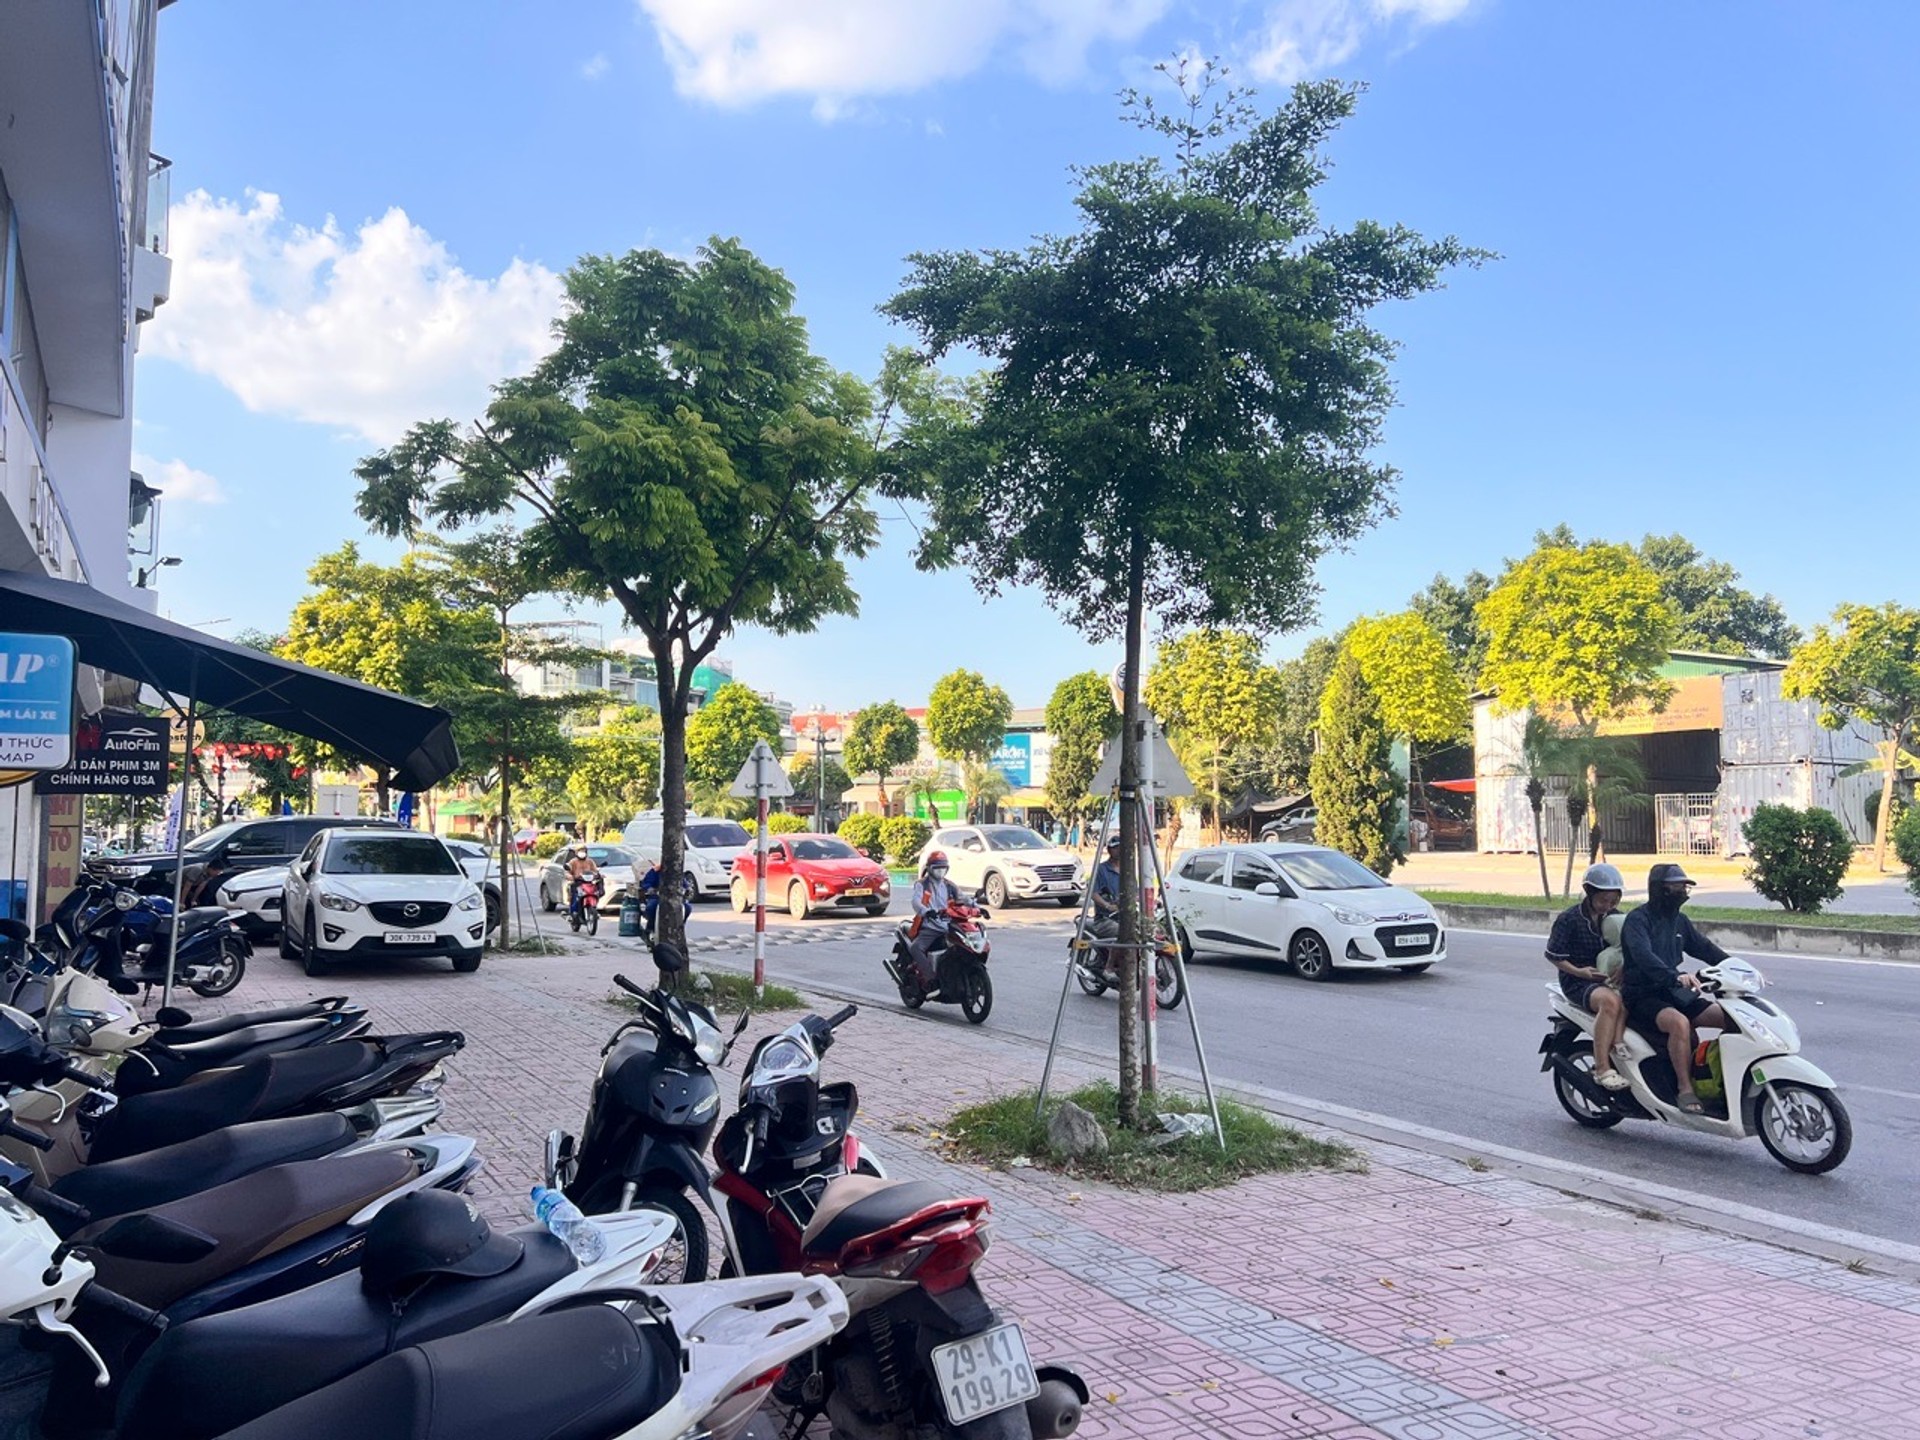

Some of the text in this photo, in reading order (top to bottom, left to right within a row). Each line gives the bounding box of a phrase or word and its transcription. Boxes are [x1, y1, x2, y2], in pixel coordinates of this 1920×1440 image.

[15, 708, 36, 719] LÁI
[40, 711, 57, 720] XE
[8, 736, 54, 749] THỨC
[104, 738, 160, 752] AutoFilm
[80, 758, 106, 770] DÁN
[110, 761, 139, 771] PHIM
[143, 761, 160, 771] 3M
[50, 772, 156, 785] CHÍNH HÃNG USA
[946, 1331, 1014, 1381] 29-K1
[950, 1362, 1033, 1416] 199.29
